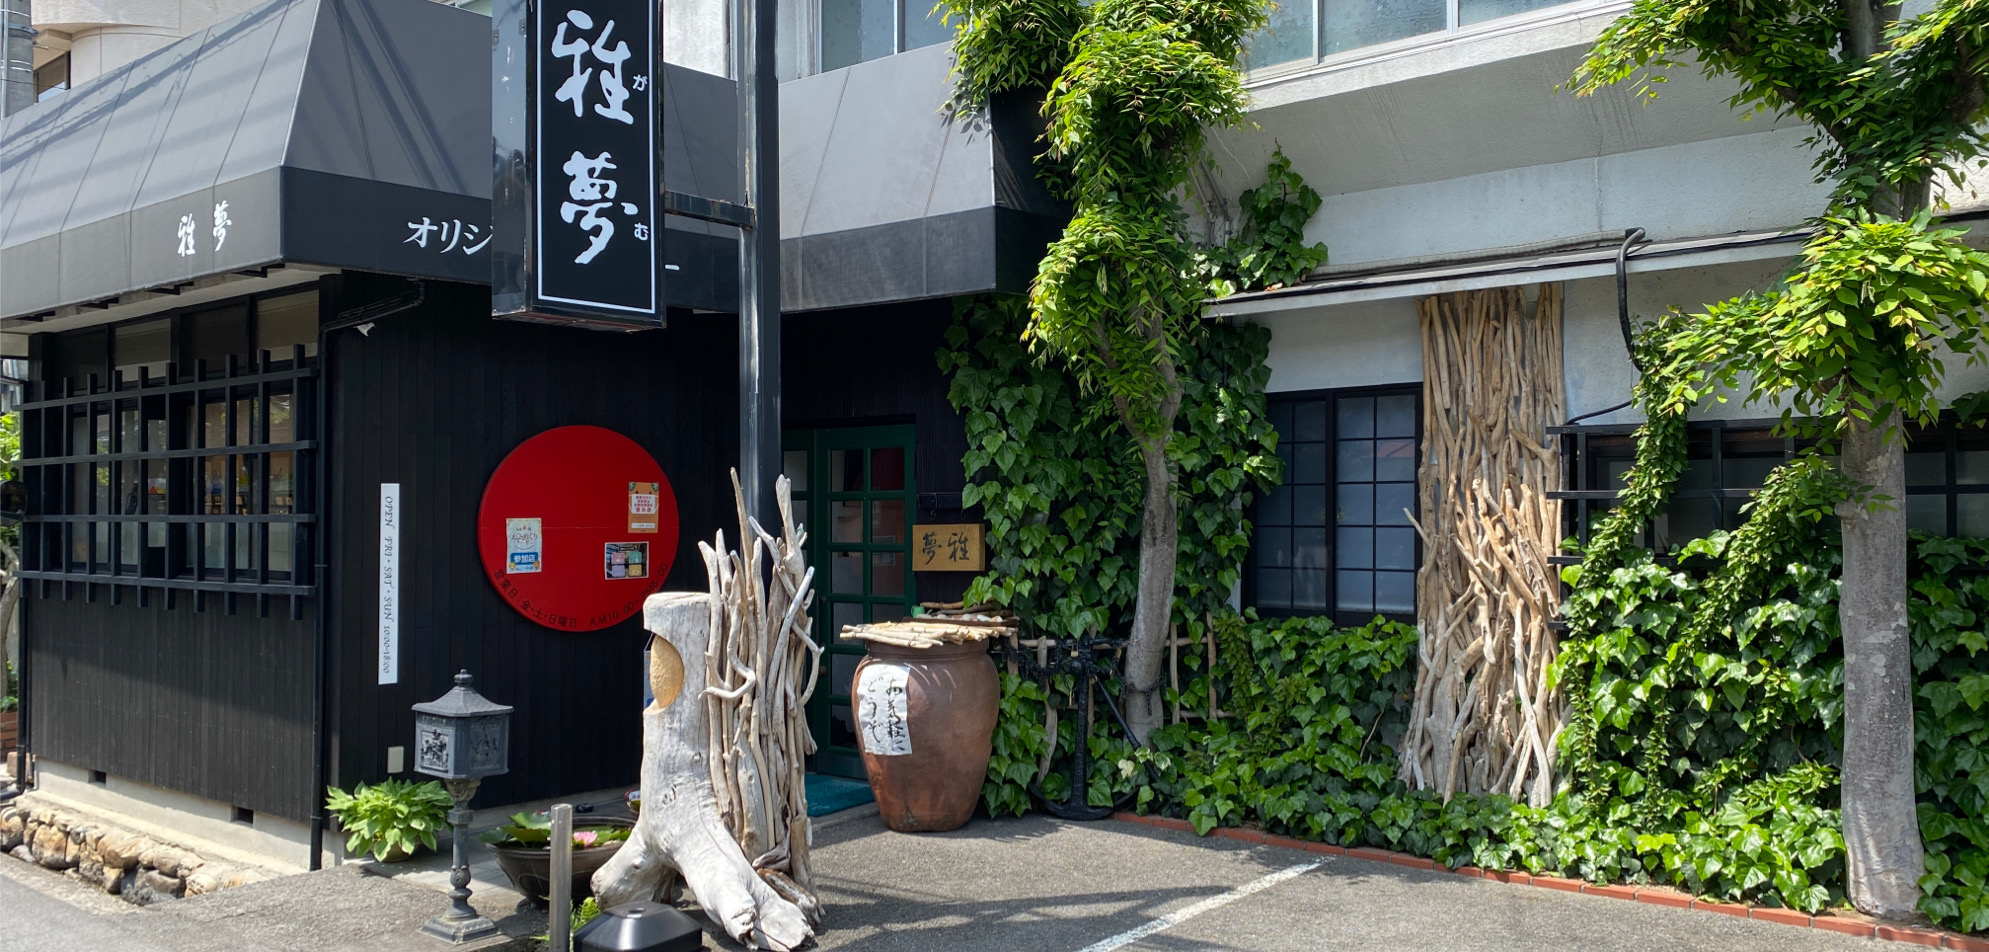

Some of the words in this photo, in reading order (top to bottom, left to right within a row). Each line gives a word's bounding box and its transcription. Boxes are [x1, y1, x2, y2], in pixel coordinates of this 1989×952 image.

[632, 74, 648, 92] が
[634, 222, 649, 241] む
[385, 496, 395, 530] OPEN
[513, 554, 536, 563] 参加店
[867, 676, 884, 744] どうぞ
